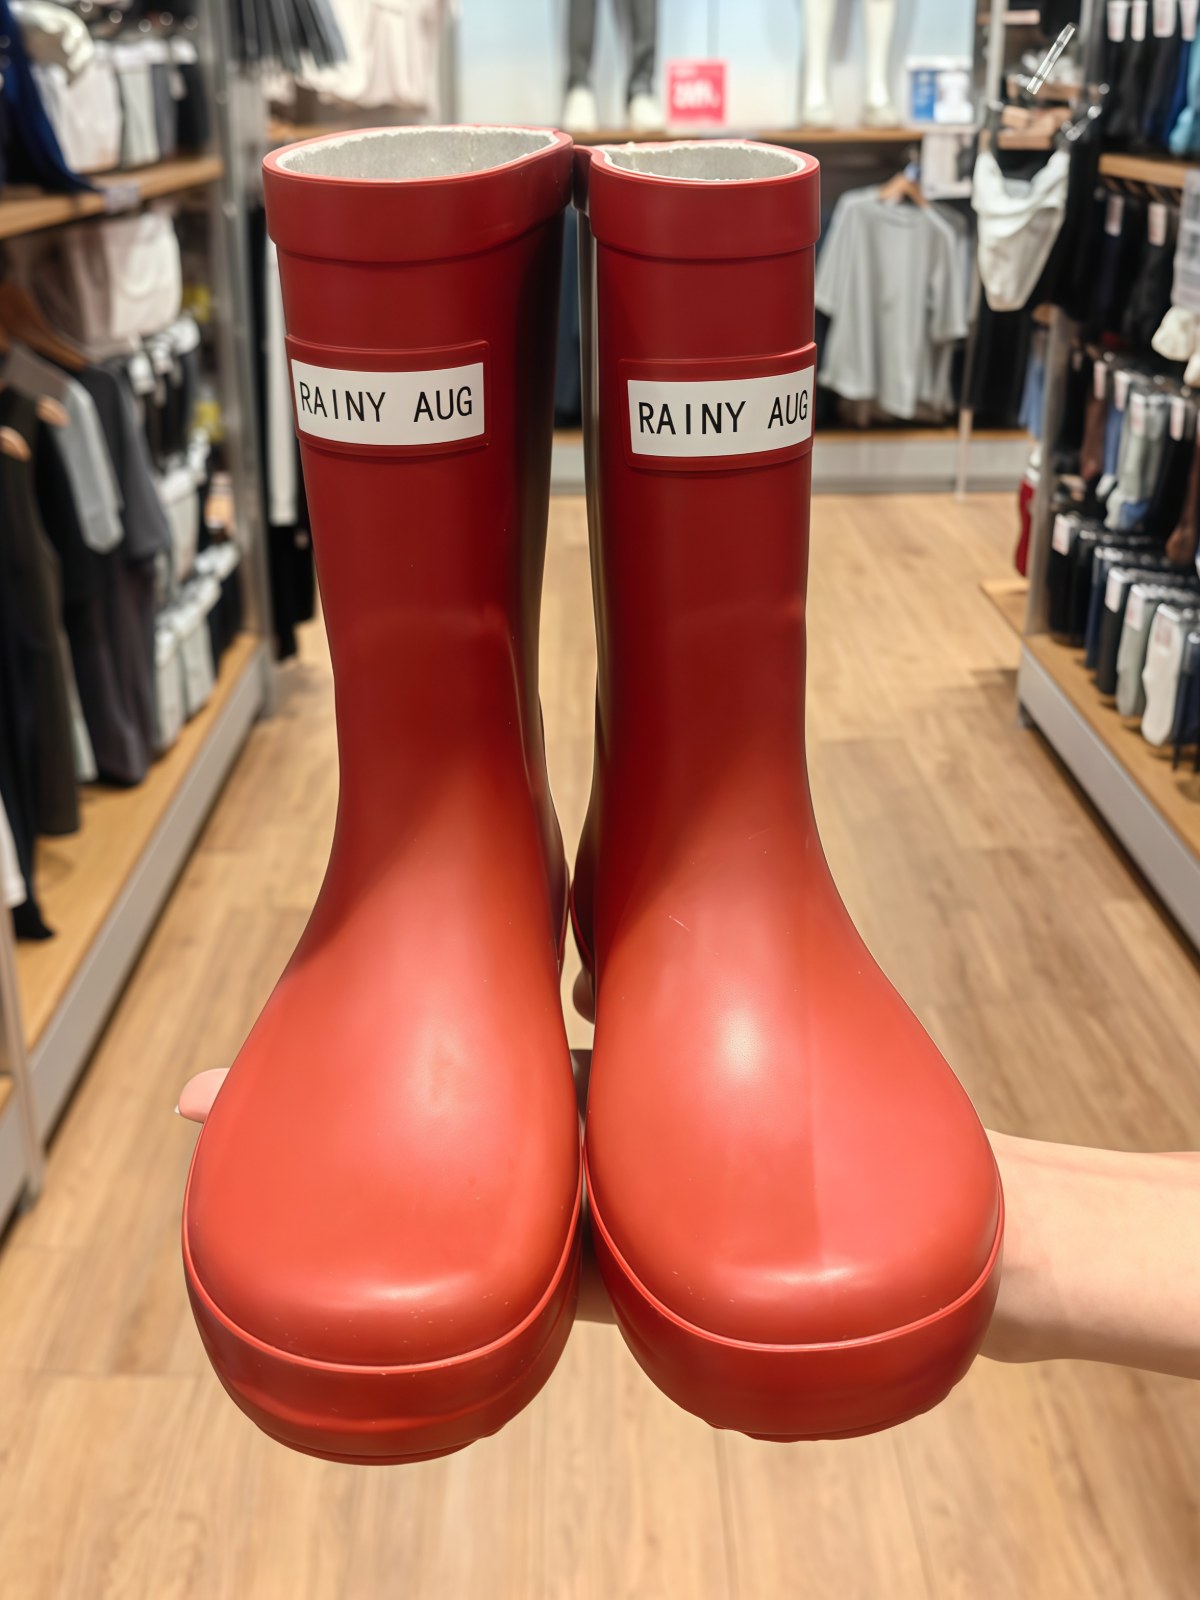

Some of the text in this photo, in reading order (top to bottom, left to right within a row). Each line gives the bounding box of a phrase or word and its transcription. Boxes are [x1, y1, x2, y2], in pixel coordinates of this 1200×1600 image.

[299, 381, 473, 422] RAINY AUG
[639, 390, 808, 434] RAINY AUG
